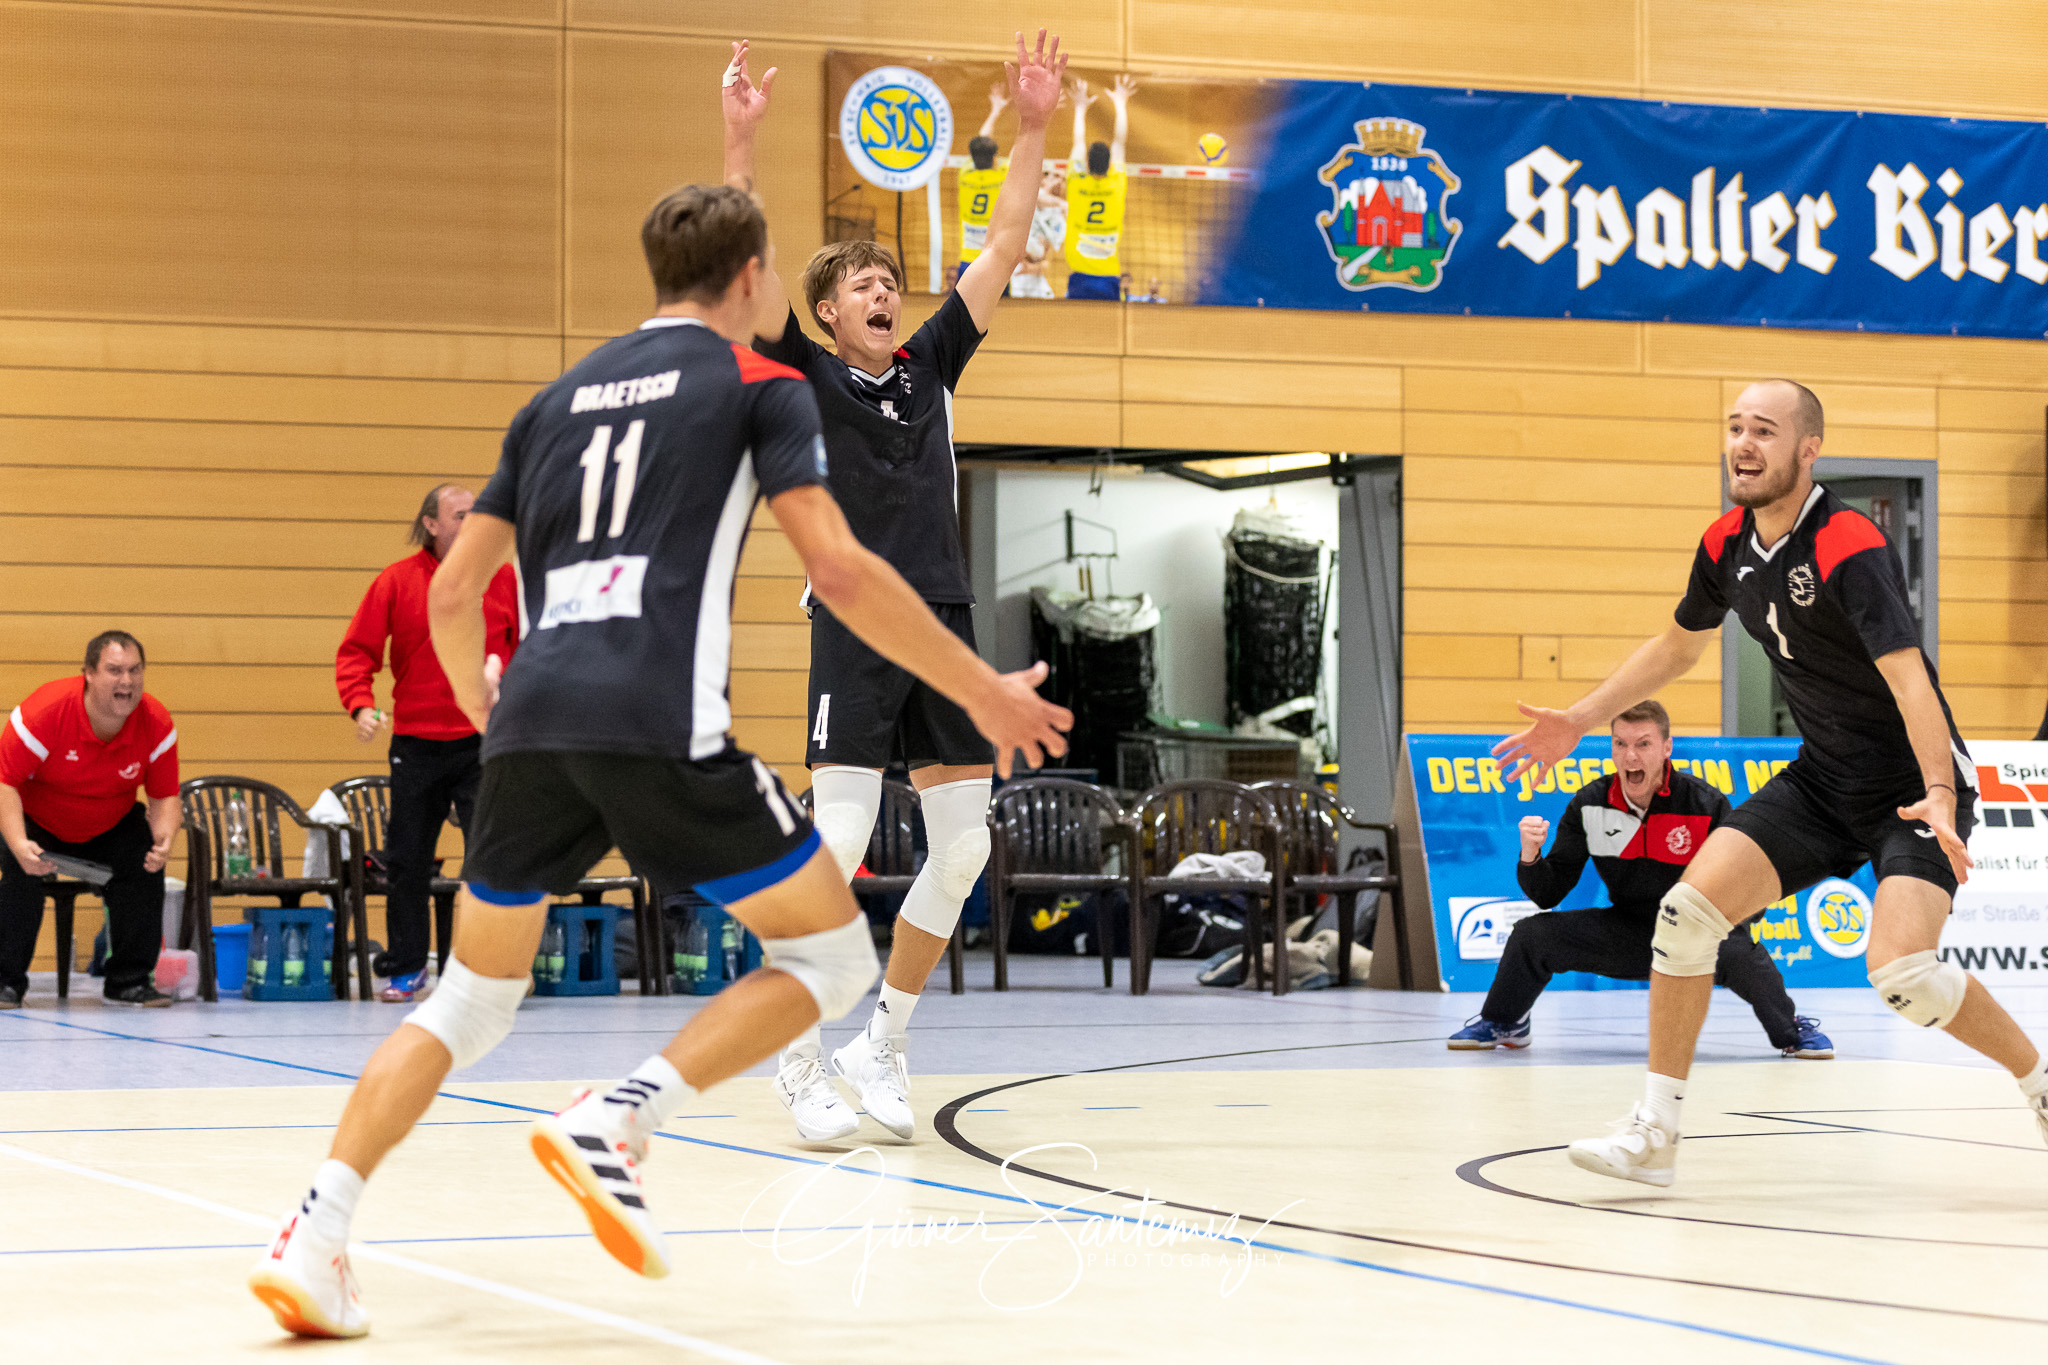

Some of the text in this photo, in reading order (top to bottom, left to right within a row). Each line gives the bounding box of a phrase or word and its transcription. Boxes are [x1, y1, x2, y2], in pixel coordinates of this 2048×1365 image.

[971, 193, 989, 215] 9
[1087, 201, 1105, 223] 2
[1498, 145, 2048, 290] Spalter Bier
[577, 419, 646, 543] 11
[1766, 601, 1795, 660] 1
[812, 693, 831, 750] 4
[1427, 757, 1506, 793] DER
[1517, 757, 1618, 801] JUGE
[1975, 855, 2010, 870] alist
[2016, 855, 2038, 870] für
[1750, 917, 1801, 944] yball
[1982, 904, 2040, 922] Straße
